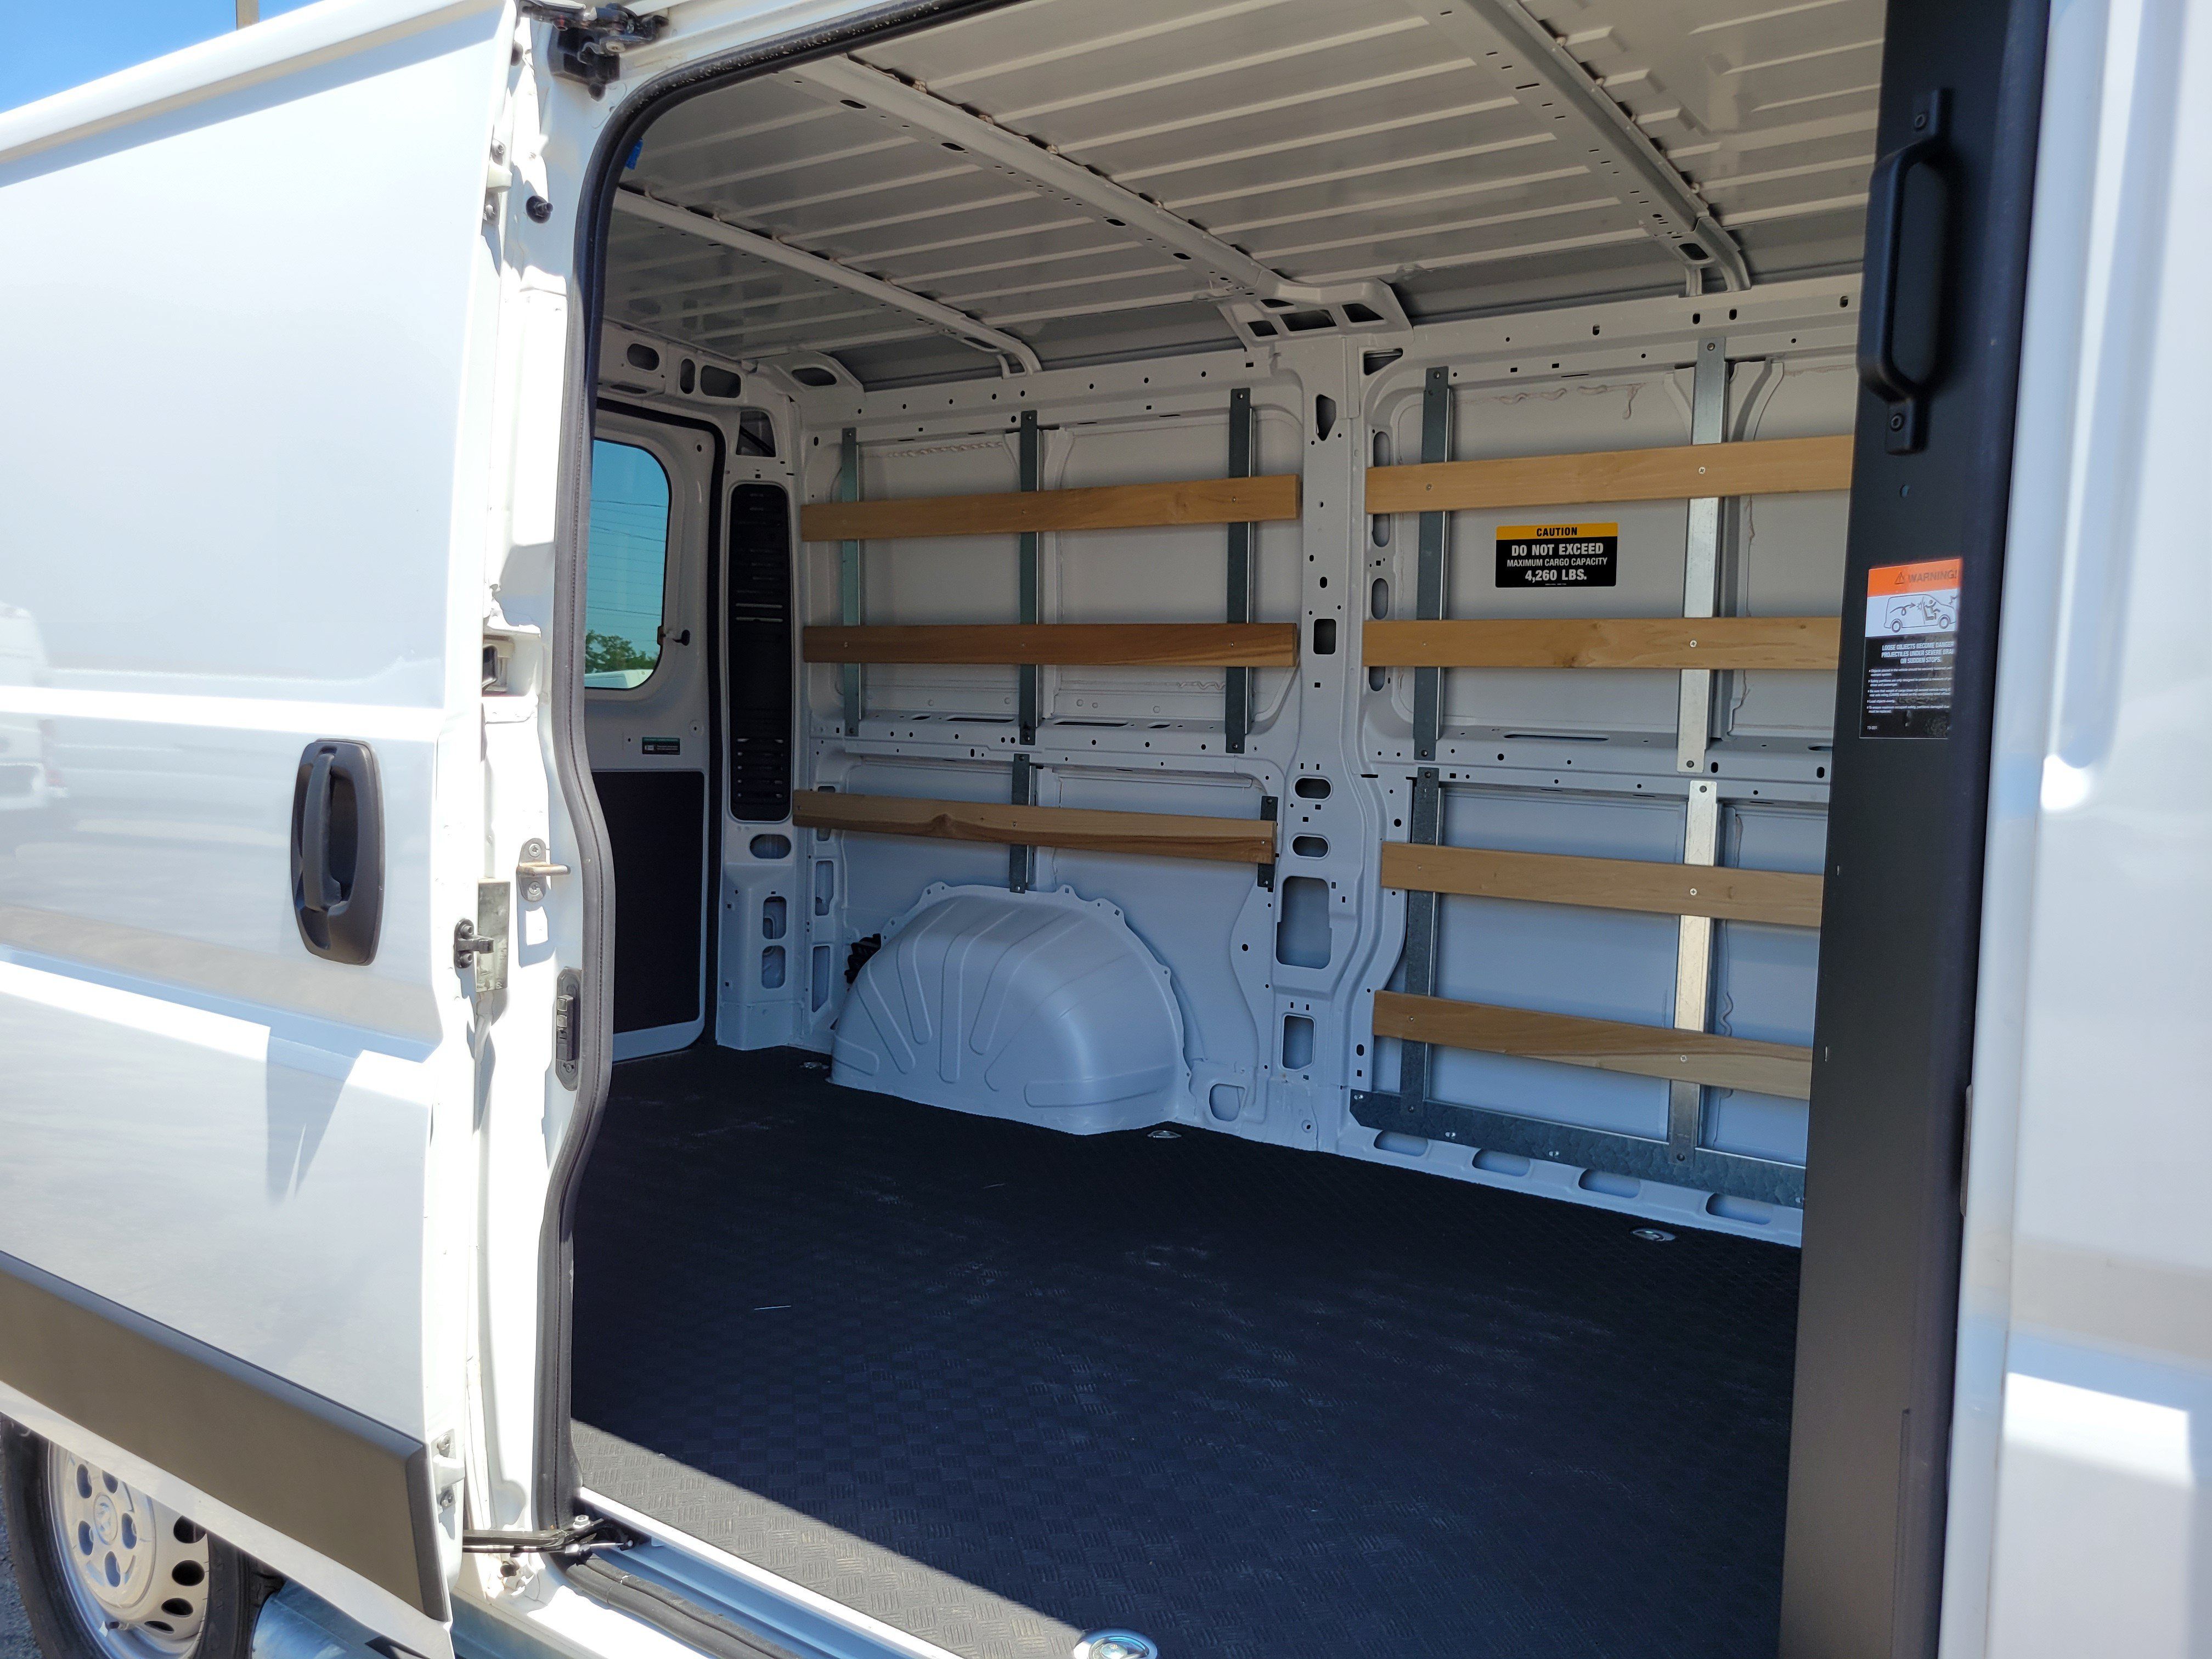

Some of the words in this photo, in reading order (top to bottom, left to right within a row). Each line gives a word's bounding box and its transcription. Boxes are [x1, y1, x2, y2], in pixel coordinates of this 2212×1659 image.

[1536, 527, 1578, 537] CAUTION
[1511, 545, 1527, 556] DO
[1532, 544, 1555, 556] NOT
[1559, 543, 1604, 555] EXCEED
[1507, 558, 1543, 567] MAXIMUM
[1544, 558, 1569, 566] CARGO
[1571, 557, 1607, 566] CAPACITY
[1525, 569, 1557, 583] 4,260
[1561, 569, 1587, 580] LBS.
